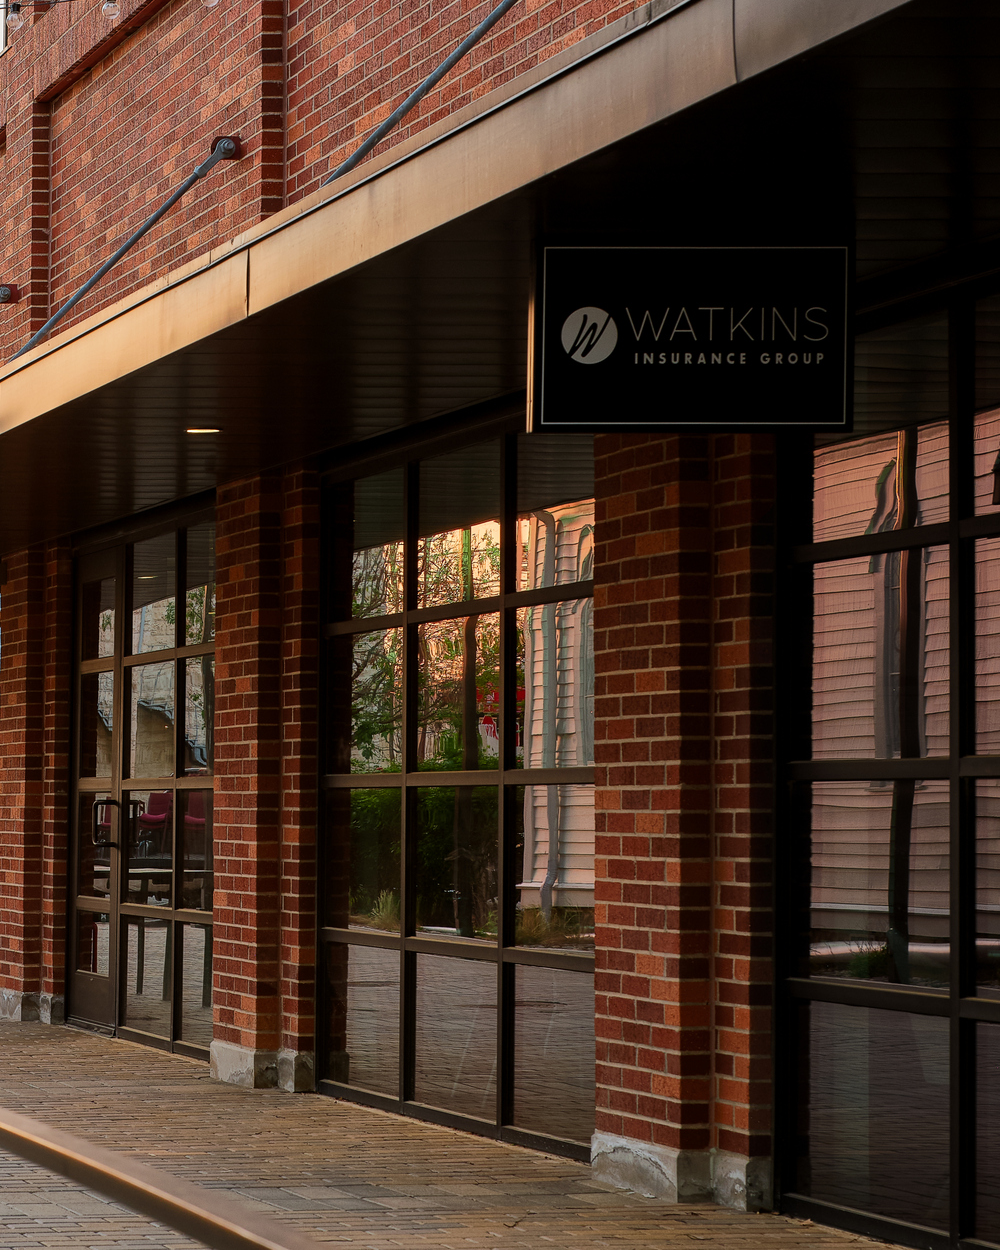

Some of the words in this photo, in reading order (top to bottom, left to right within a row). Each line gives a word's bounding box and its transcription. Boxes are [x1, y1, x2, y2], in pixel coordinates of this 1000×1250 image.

[625, 307, 829, 341] WATKINS
[634, 352, 748, 365] INSURANCE
[760, 352, 825, 365] GROUP
